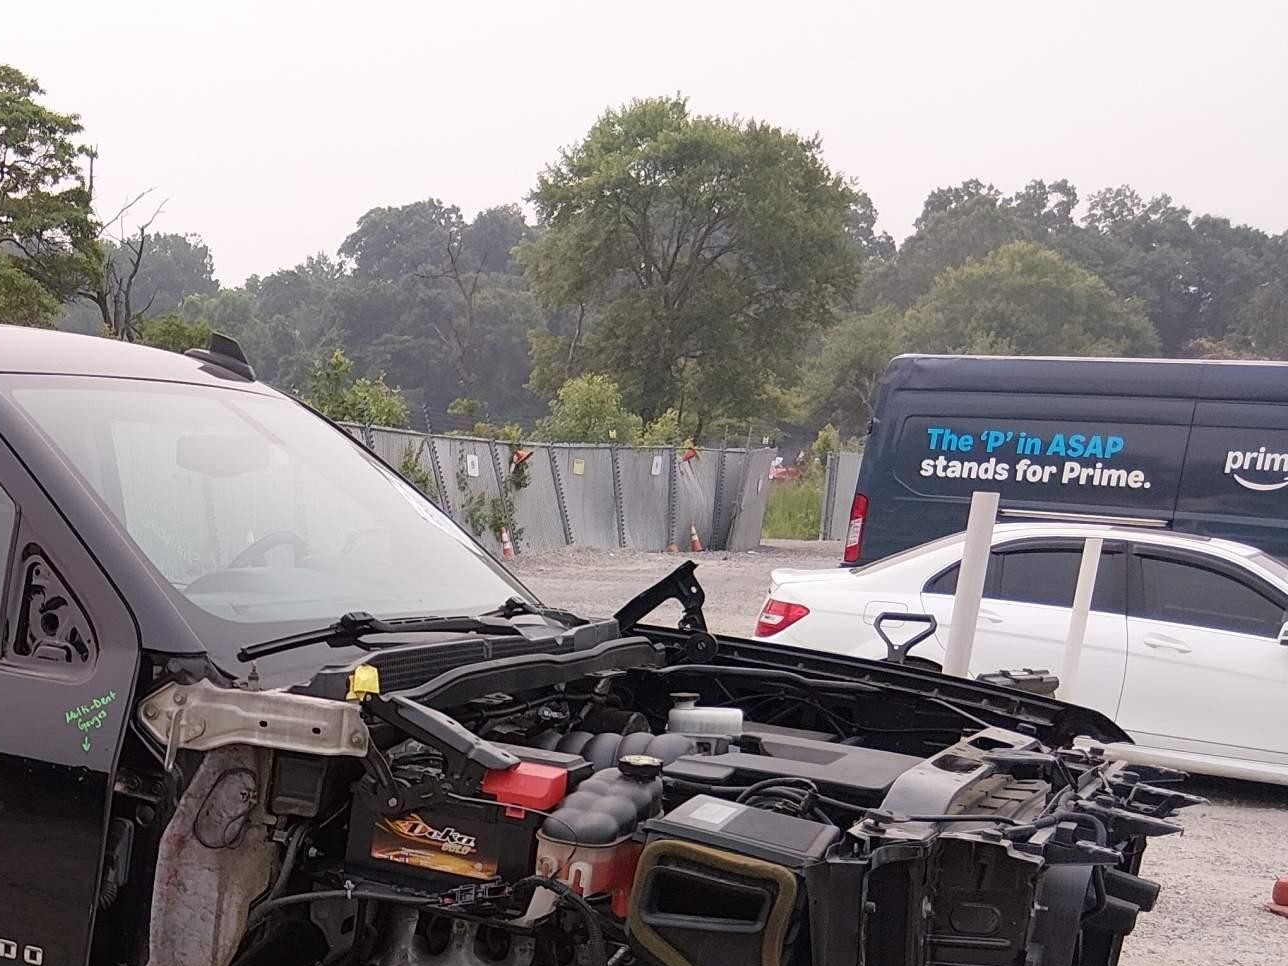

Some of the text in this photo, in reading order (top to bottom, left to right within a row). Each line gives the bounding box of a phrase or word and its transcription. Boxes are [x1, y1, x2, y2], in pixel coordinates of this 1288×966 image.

[927, 428, 974, 452] The
[1016, 431, 1042, 455] in
[1046, 433, 1124, 459] ASAP
[919, 455, 1152, 489] stands for Prime.
